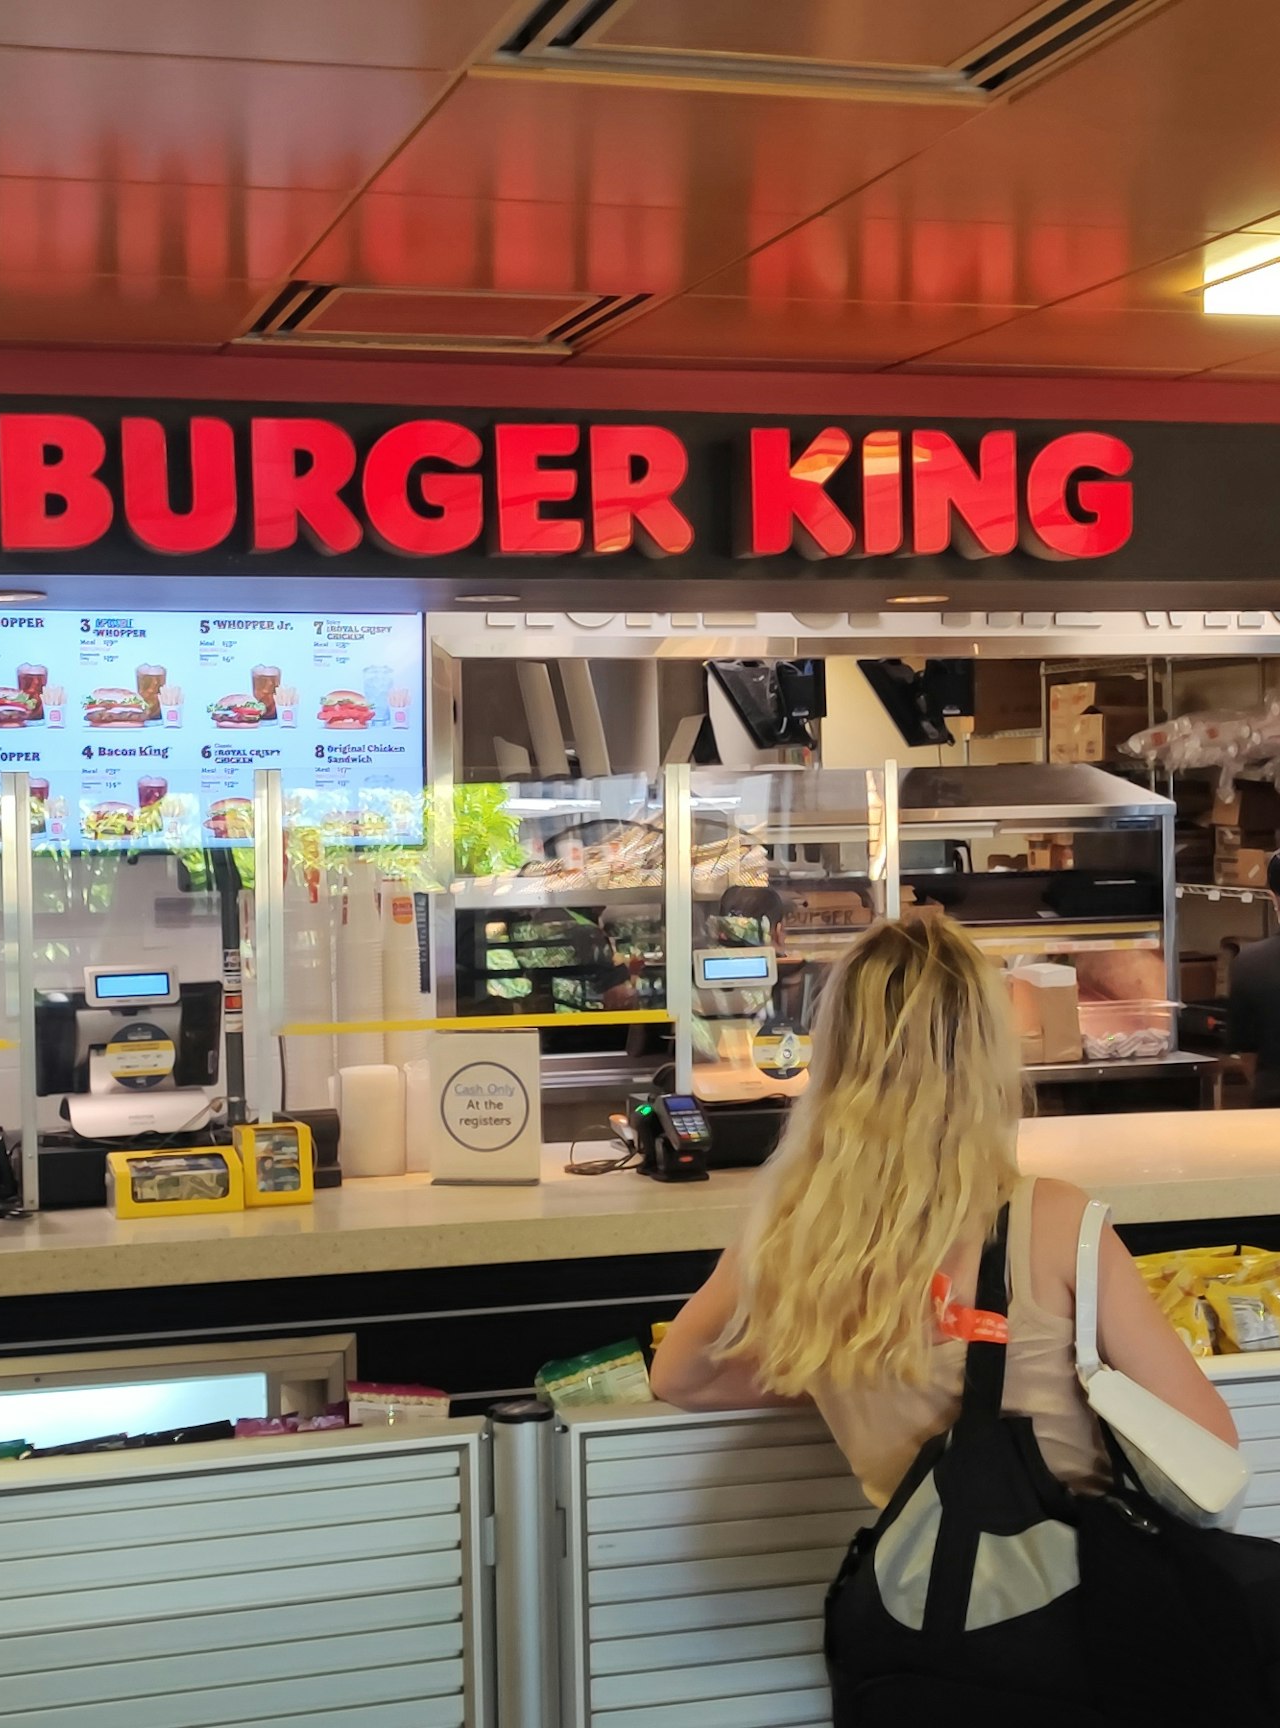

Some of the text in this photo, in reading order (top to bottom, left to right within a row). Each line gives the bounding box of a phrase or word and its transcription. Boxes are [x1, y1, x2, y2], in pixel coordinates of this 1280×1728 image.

[750, 425, 1134, 557] KING
[79, 618, 91, 633] 3
[199, 619, 294, 634] 5 WHOPPER Jr.
[313, 621, 324, 635] 7
[93, 629, 147, 638] WHOPPER
[81, 744, 170, 760] 4 Bacon King
[200, 744, 212, 759] 6
[314, 744, 405, 758] 8 Original Chicken
[327, 754, 373, 764] Sandwich
[454, 1083, 516, 1097] Cash Only
[465, 1098, 504, 1111] At the
[458, 1115, 512, 1129] registers
